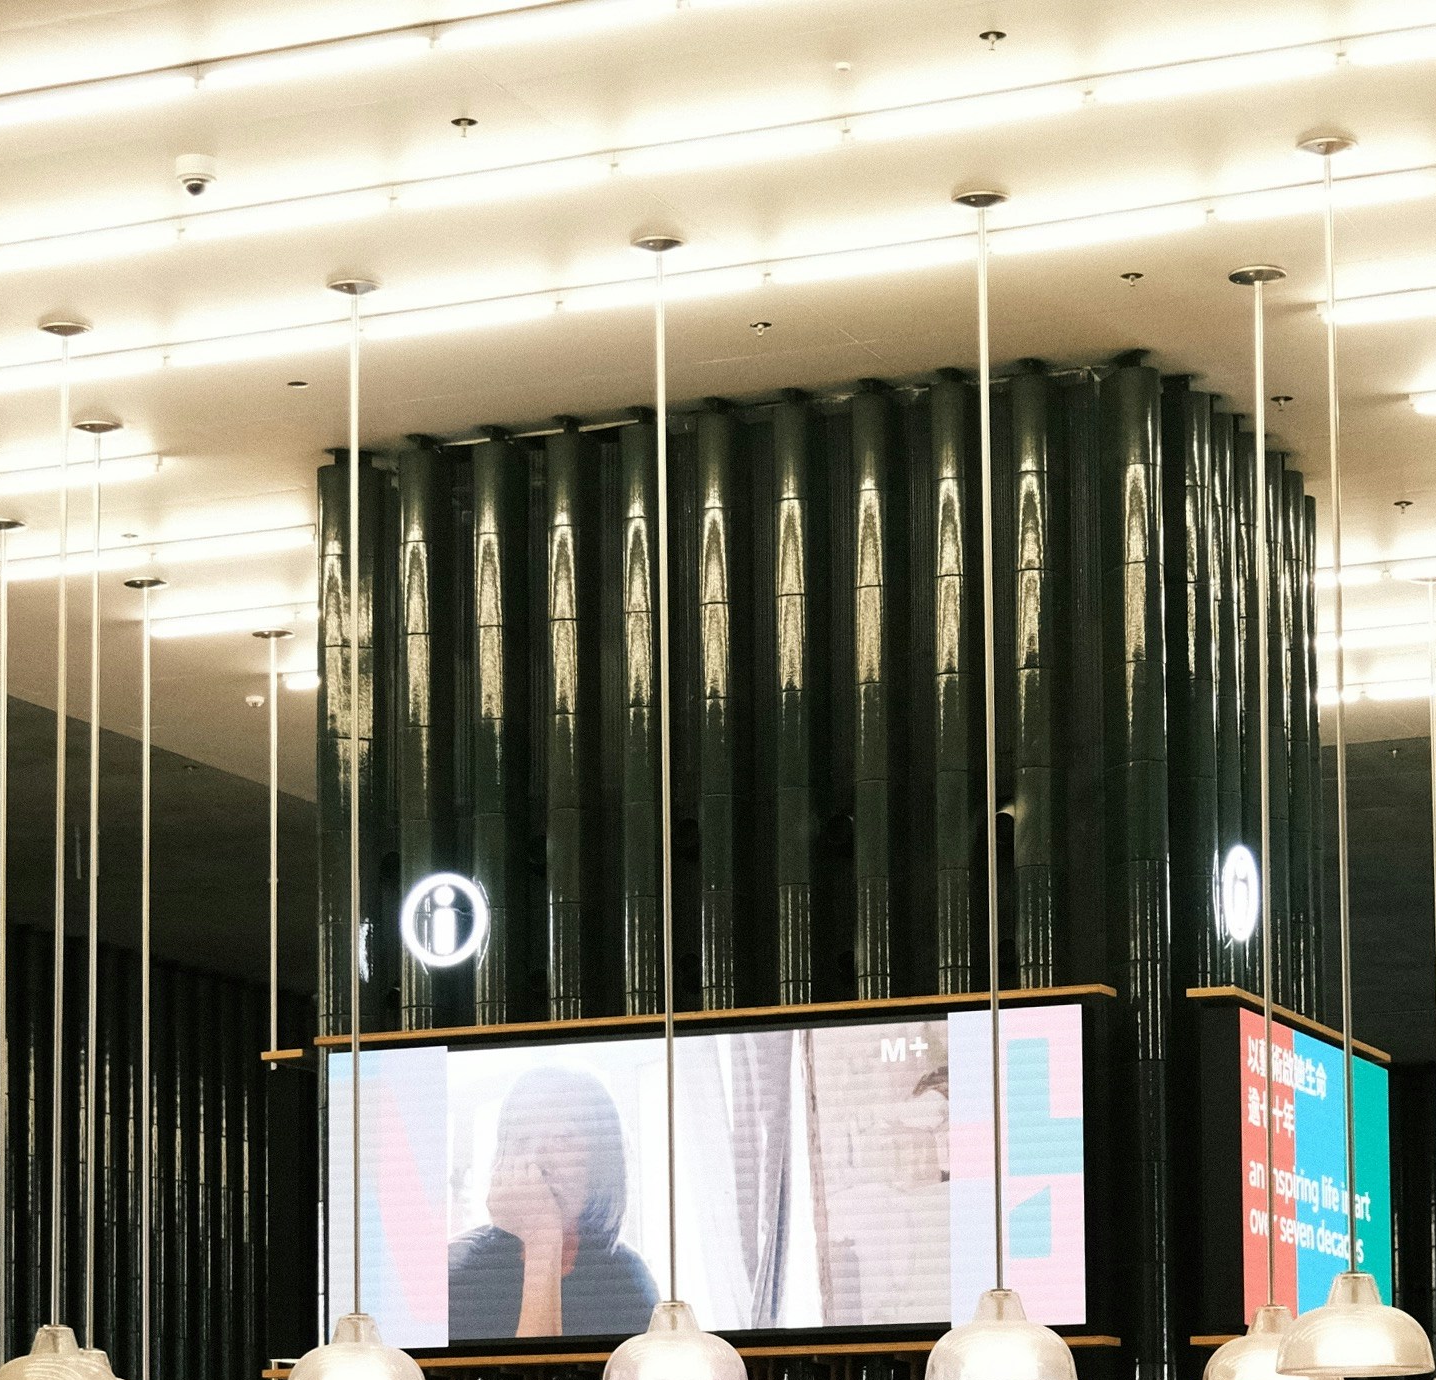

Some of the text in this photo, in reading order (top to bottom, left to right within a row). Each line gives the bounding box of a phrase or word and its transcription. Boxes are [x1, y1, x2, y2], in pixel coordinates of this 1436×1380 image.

[881, 1036, 929, 1062] M+
[1248, 1160, 1265, 1190] an
[1272, 1165, 1320, 1214] nspiring
[1321, 1174, 1340, 1212] life
[1279, 1216, 1315, 1251] seven
